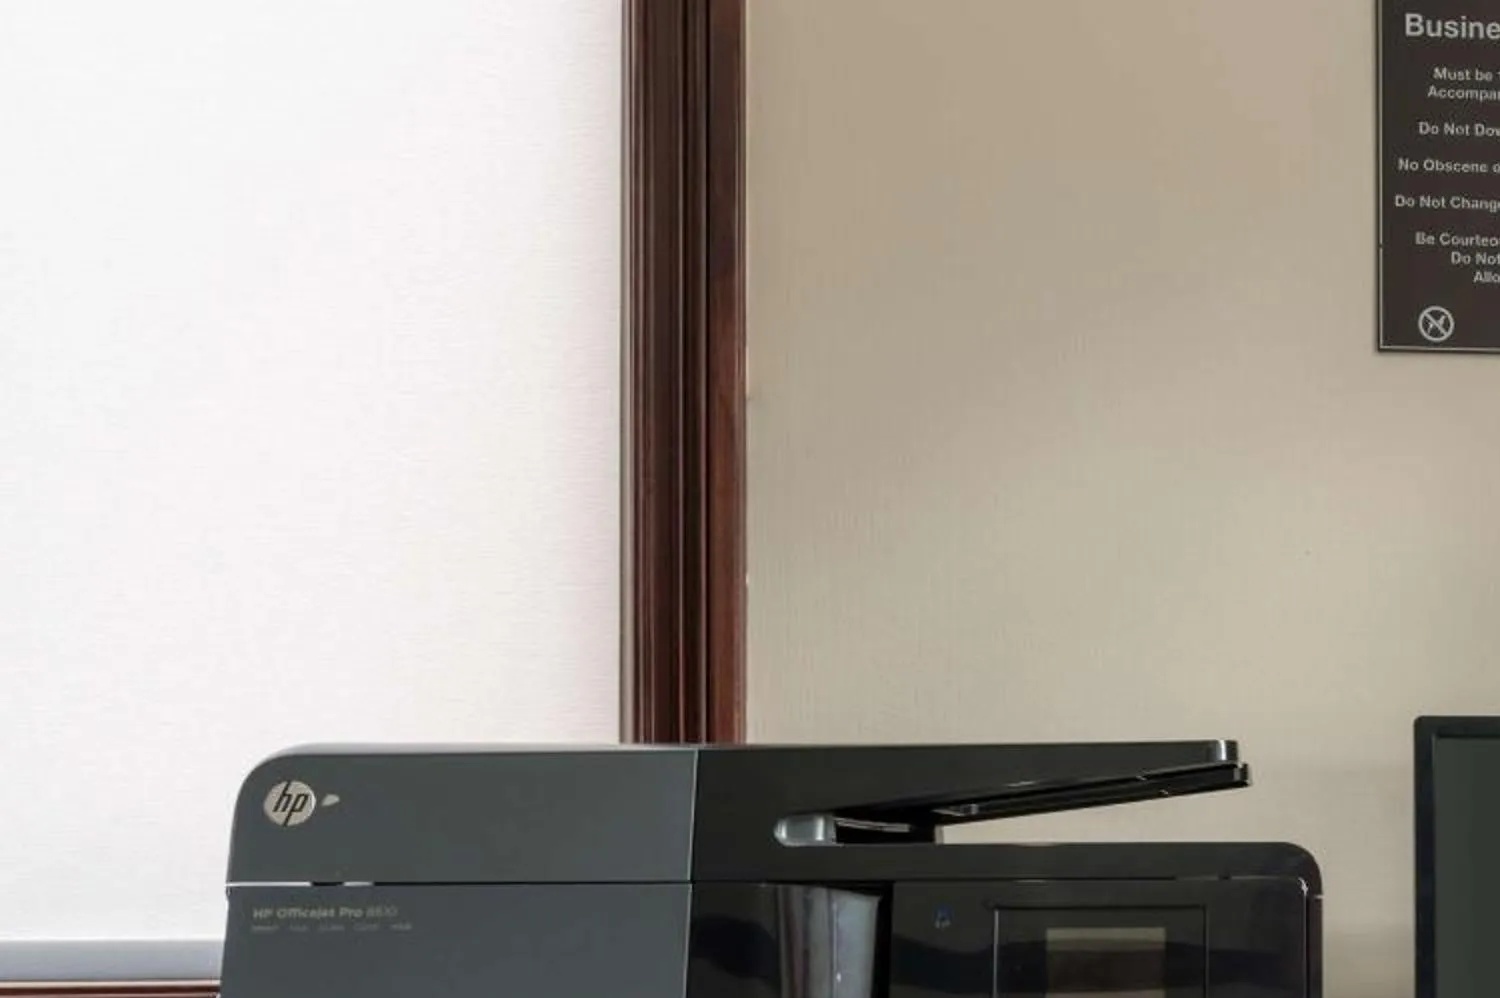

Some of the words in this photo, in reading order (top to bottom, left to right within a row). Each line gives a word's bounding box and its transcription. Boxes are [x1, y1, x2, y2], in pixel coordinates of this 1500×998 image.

[1432, 66, 1471, 81] Must
[1475, 68, 1493, 82] be
[1418, 121, 1439, 135] Do
[1443, 122, 1471, 137] Not
[1397, 158, 1419, 172] No
[1423, 159, 1488, 173] Obscene
[1395, 194, 1415, 207] Do
[1419, 195, 1446, 209] Not
[1415, 231, 1435, 245] Be
[1450, 251, 1471, 265] Do
[272, 779, 309, 828] hp
[338, 906, 363, 919] Pro
